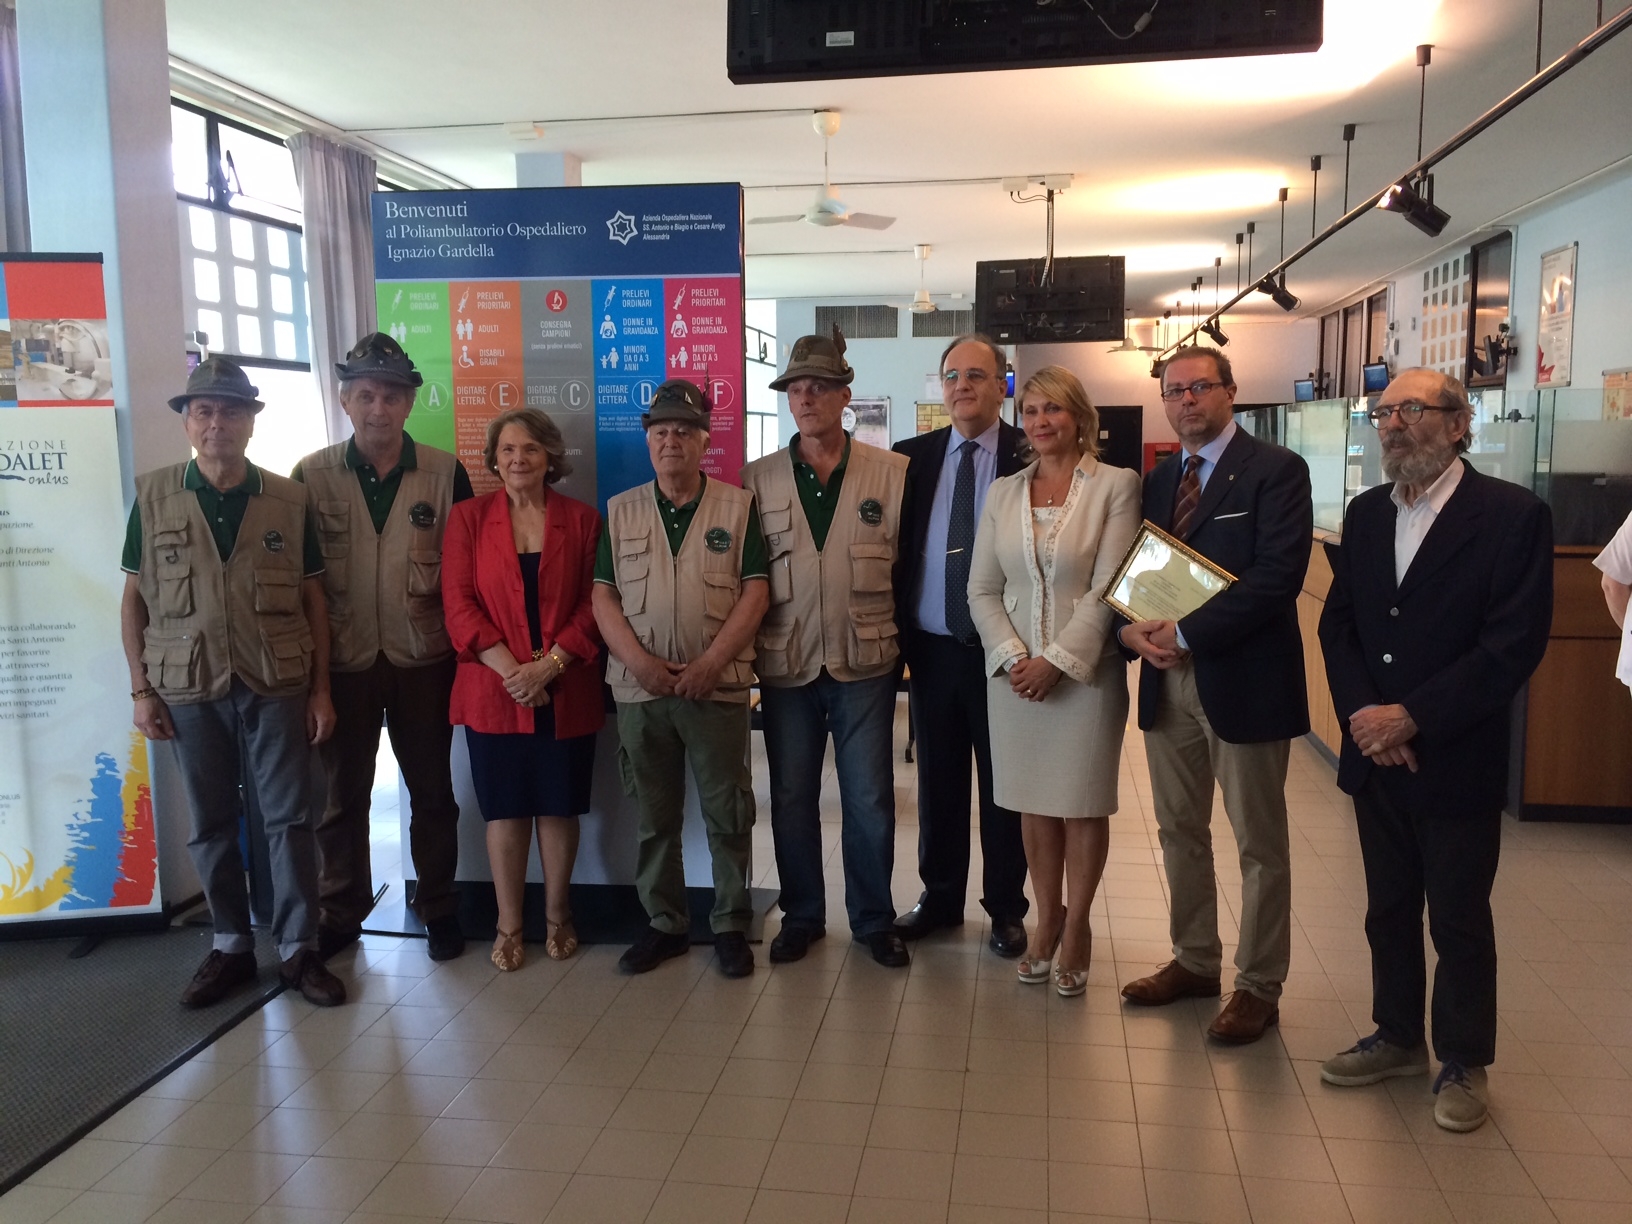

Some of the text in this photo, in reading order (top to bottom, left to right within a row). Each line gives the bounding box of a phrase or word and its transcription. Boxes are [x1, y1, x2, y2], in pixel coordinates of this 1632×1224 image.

[385, 201, 468, 219] Benvenuti
[642, 213, 713, 222] Azienda Ospedaliera Nazionale
[385, 221, 587, 240] al Poliambulatorio Ospedaliero
[675, 223, 690, 232] Biagio
[694, 222, 711, 230] Cesare
[711, 222, 726, 231] Arrigo
[643, 233, 671, 241] Alessandria
[387, 243, 495, 263] Ignazio Gardella
[409, 293, 437, 301] PRELIEVI
[477, 292, 504, 300] PRELIEVI
[622, 290, 650, 298] PRELIEVI
[691, 289, 719, 297] PRELIEVI
[410, 302, 439, 311] ORDINARI
[477, 302, 511, 310] PRIORITARI
[622, 300, 652, 308] ORDINARI
[691, 298, 726, 307] PRIORITARI
[540, 321, 572, 329] CONSEGNA
[622, 318, 644, 326] DONNE
[692, 317, 714, 325] DONNE
[411, 325, 432, 333] ADULTI
[478, 325, 499, 333] ADULTI
[623, 327, 659, 335] GRAVIDANZA
[692, 326, 728, 334] GRAVIDANZA
[541, 330, 571, 338] CAMPIONI
[479, 349, 505, 357] DISABILI
[623, 346, 647, 354] MINORI
[692, 345, 716, 353] MINORI
[480, 358, 498, 366] GRAVI
[624, 355, 633, 363] DA
[692, 354, 701, 362] DA
[624, 363, 639, 371] ANNI
[692, 362, 708, 371] ANNI
[456, 386, 487, 395] DIGITARE
[527, 385, 557, 394] DIGITARE
[598, 385, 629, 394] DIGITARE
[640, 382, 652, 405] D
[713, 382, 724, 405] F
[428, 384, 441, 407] A
[499, 384, 510, 406] E
[569, 383, 580, 406] C
[457, 396, 486, 405] LETTERA
[527, 396, 556, 405] LETTERA
[598, 395, 628, 404] LETTERA
[0, 440, 67, 451] ZIONE
[704, 448, 726, 456] GUITI:
[28, 472, 69, 485] onlus
[5, 546, 14, 554] di
[15, 546, 55, 554] Direzione
[16, 559, 50, 567] Antonio
[21, 622, 76, 632] collaborando
[7, 637, 29, 645] Santi
[31, 636, 65, 644] Antonio
[1, 649, 50, 659] per favorire
[38, 685, 66, 693] offrire
[13, 699, 57, 708] impegnati
[16, 711, 49, 719] sanitari
